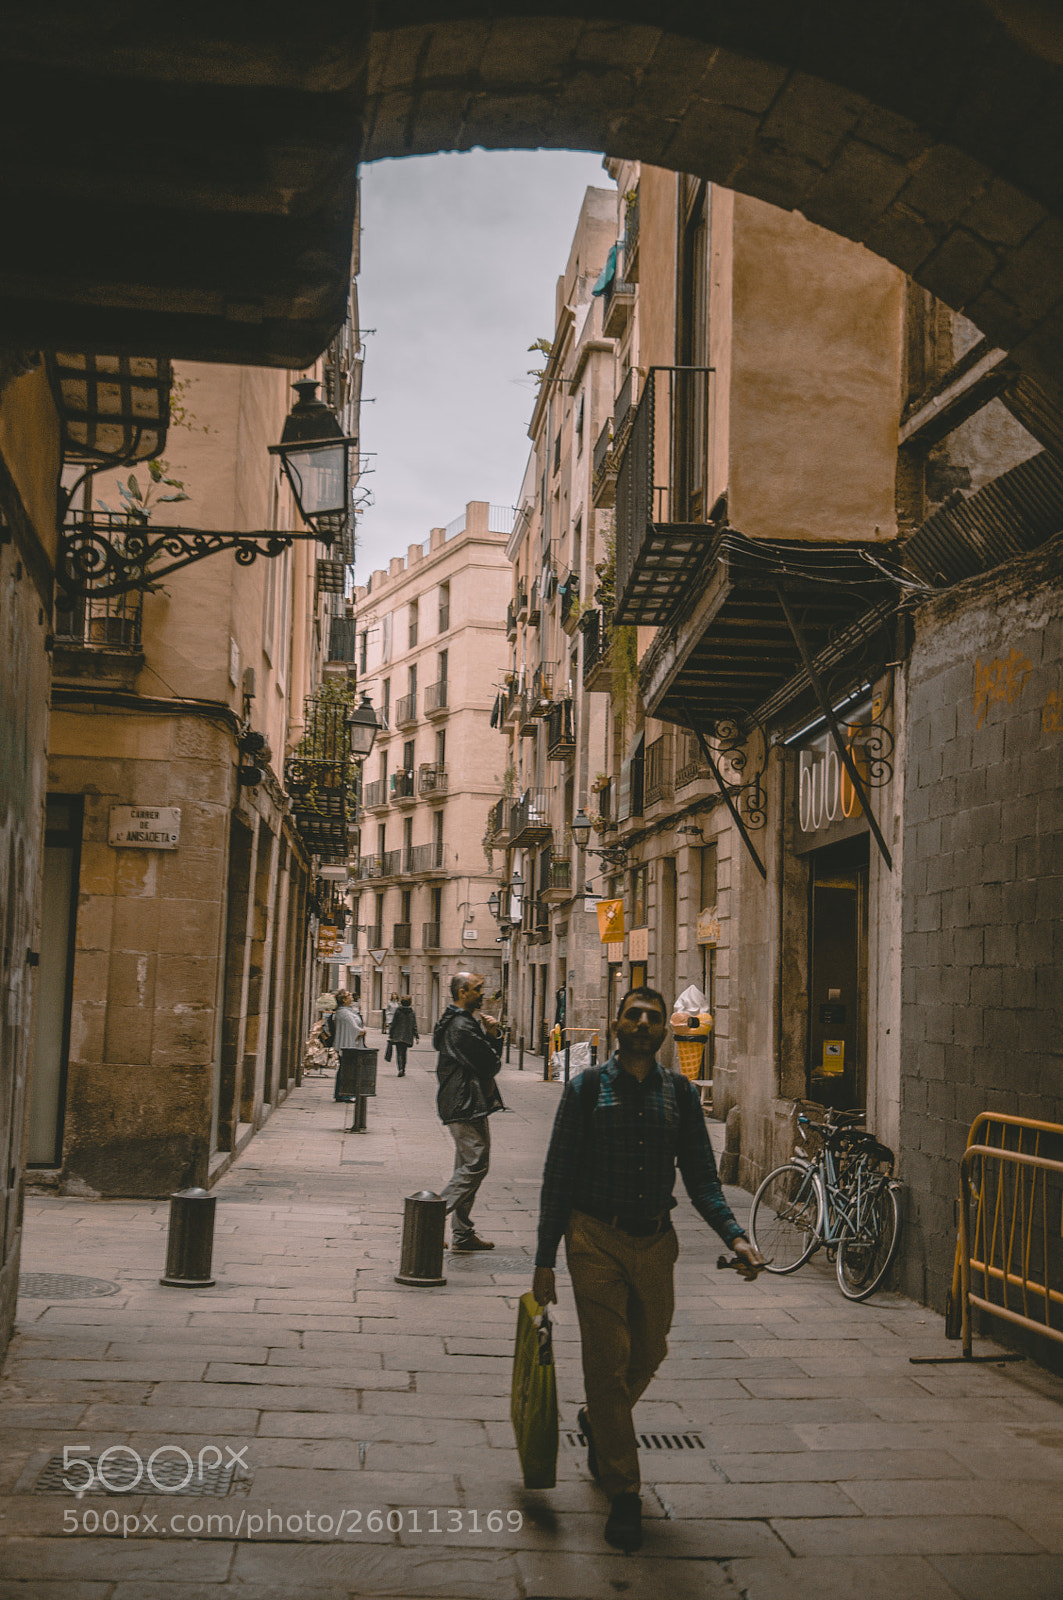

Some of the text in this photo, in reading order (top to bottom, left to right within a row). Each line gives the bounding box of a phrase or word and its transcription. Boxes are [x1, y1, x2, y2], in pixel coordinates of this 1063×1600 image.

[131, 811, 159, 819] CARRER
[140, 821, 149, 829] DE
[127, 831, 169, 842] ANISADETA
